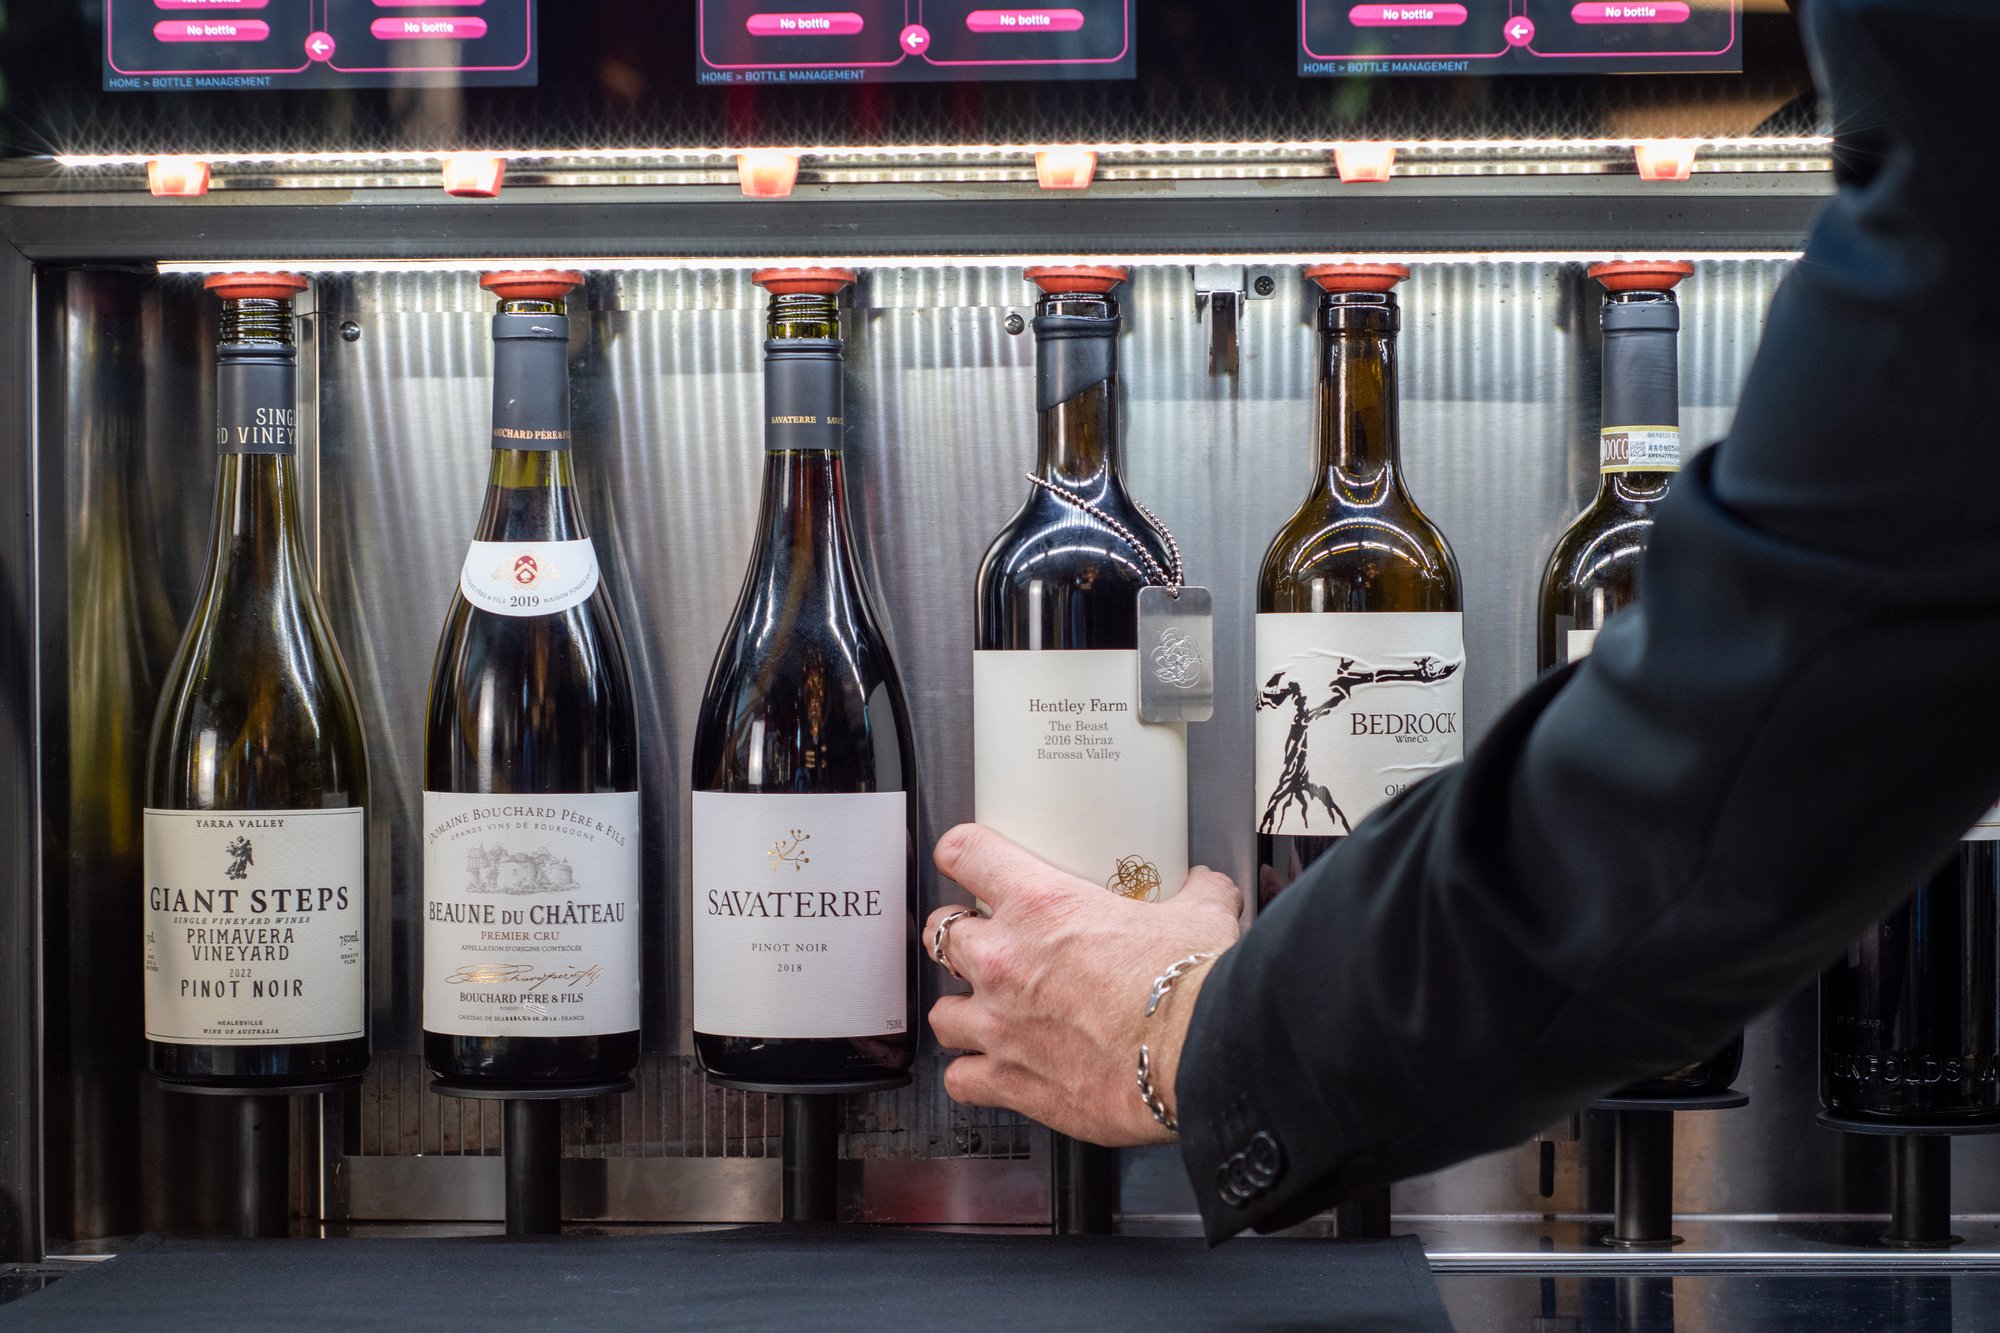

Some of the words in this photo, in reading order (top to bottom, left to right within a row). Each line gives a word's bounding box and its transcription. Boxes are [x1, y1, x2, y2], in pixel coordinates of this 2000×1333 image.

[1383, 9, 1399, 20] No
[1401, 9, 1433, 20] bottle
[1605, 7, 1621, 17] No
[1623, 6, 1656, 17] bottle
[780, 18, 795, 29] No
[798, 18, 830, 29] bottle
[1000, 15, 1016, 26] No
[1018, 14, 1050, 26] bottle
[187, 25, 201, 36] No
[204, 24, 237, 36] bottle
[404, 22, 420, 33] No
[422, 22, 454, 33] bottle
[1303, 63, 1335, 73] HOME
[1348, 62, 1389, 72] BOTTLE
[1392, 61, 1469, 72] MANAGEMENT
[109, 78, 140, 88] HOME
[152, 77, 193, 87] BOTTLE
[195, 76, 271, 87] MANAGEMENT
[701, 72, 733, 82] HOME
[745, 71, 786, 81] BOTTLE
[789, 70, 865, 80] MANAGEMENT
[771, 416, 816, 424] SAVATERRE
[237, 427, 296, 445] VINEY
[1605, 438, 1628, 461] DOCG
[510, 596, 540, 607] 2019
[543, 592, 569, 603] MAISON
[1029, 698, 1085, 715] Hentley
[1089, 698, 1128, 712] Farm
[1048, 720, 1072, 731] The
[1075, 720, 1109, 731] Beast
[1350, 712, 1457, 735] BEDROCK
[1044, 735, 1071, 745] 2016
[1074, 735, 1114, 745] Shiraz
[1395, 735, 1416, 743] Wine
[1416, 735, 1428, 743] Co.
[1037, 749, 1083, 760] Barossa
[1086, 748, 1121, 761] Valley
[1385, 784, 1406, 796] Old
[196, 819, 233, 828] YARRA
[239, 819, 285, 828] VALLEY
[429, 812, 469, 845] DOMAINE
[473, 806, 556, 821] BOUCHARD
[561, 809, 592, 827] PÈRE
[595, 821, 603, 832] &
[605, 825, 625, 847] FILS
[450, 826, 482, 841] GRANDS
[487, 822, 510, 831] VINS
[534, 823, 595, 842] BOURGOGNE
[150, 887, 238, 914] GIANT
[250, 886, 348, 914] STEPS
[708, 889, 883, 918] SAVATERRE
[429, 900, 495, 924] BEAUNE
[501, 910, 524, 925] DU
[530, 900, 625, 925] CHÂTEAU
[173, 916, 207, 925] SINGLE
[211, 917, 271, 925] VINEYARD
[275, 916, 310, 925] WINES
[187, 928, 295, 944] PRIMAVERA
[480, 931, 529, 941] PREMIER
[533, 931, 560, 941] CRU
[192, 945, 290, 961] VINEYARD
[752, 943, 790, 952] PINOT
[796, 943, 828, 952] NOIR
[229, 968, 252, 978] 2022
[777, 963, 802, 972] 2018
[181, 979, 240, 998] PINOT
[253, 979, 303, 998] NOIR
[459, 992, 517, 1003] BOUCHARD
[520, 992, 549, 1004] PÈRE
[551, 994, 558, 1003] &
[560, 992, 584, 1003] FILS
